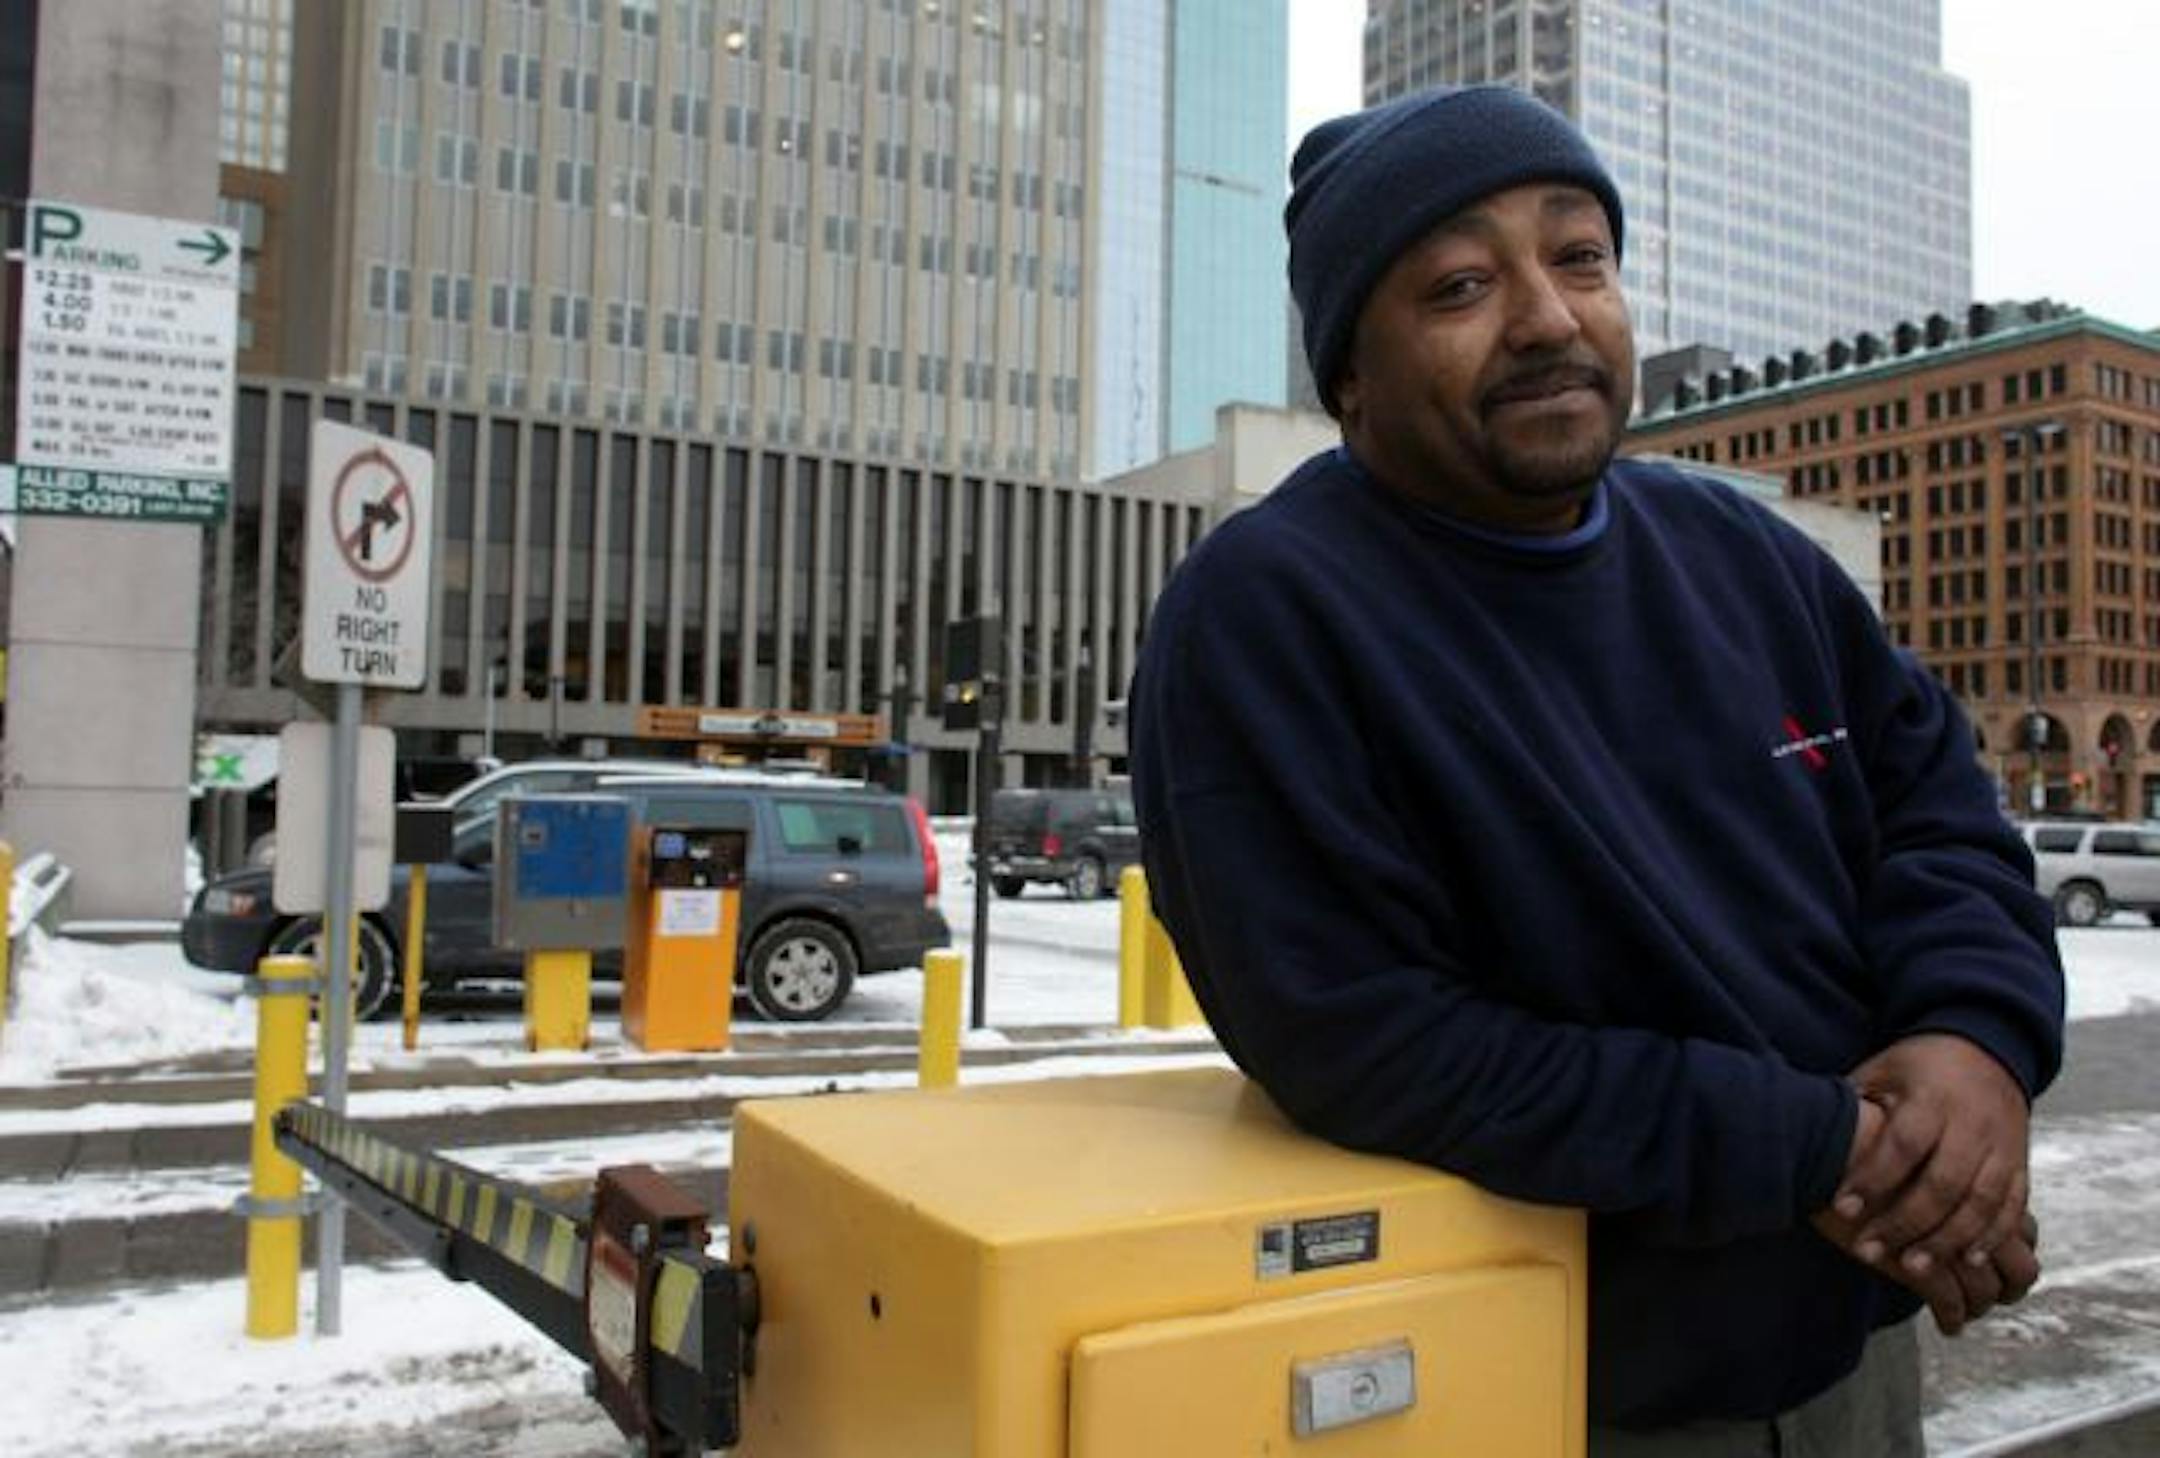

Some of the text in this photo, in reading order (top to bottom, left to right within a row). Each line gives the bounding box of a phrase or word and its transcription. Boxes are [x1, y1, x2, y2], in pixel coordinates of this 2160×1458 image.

[22, 467, 90, 491] ALLIED
[21, 488, 142, 514] 332-0391
[356, 586, 387, 614] NO
[337, 614, 401, 645] RIGHT
[340, 647, 398, 676] TURN
